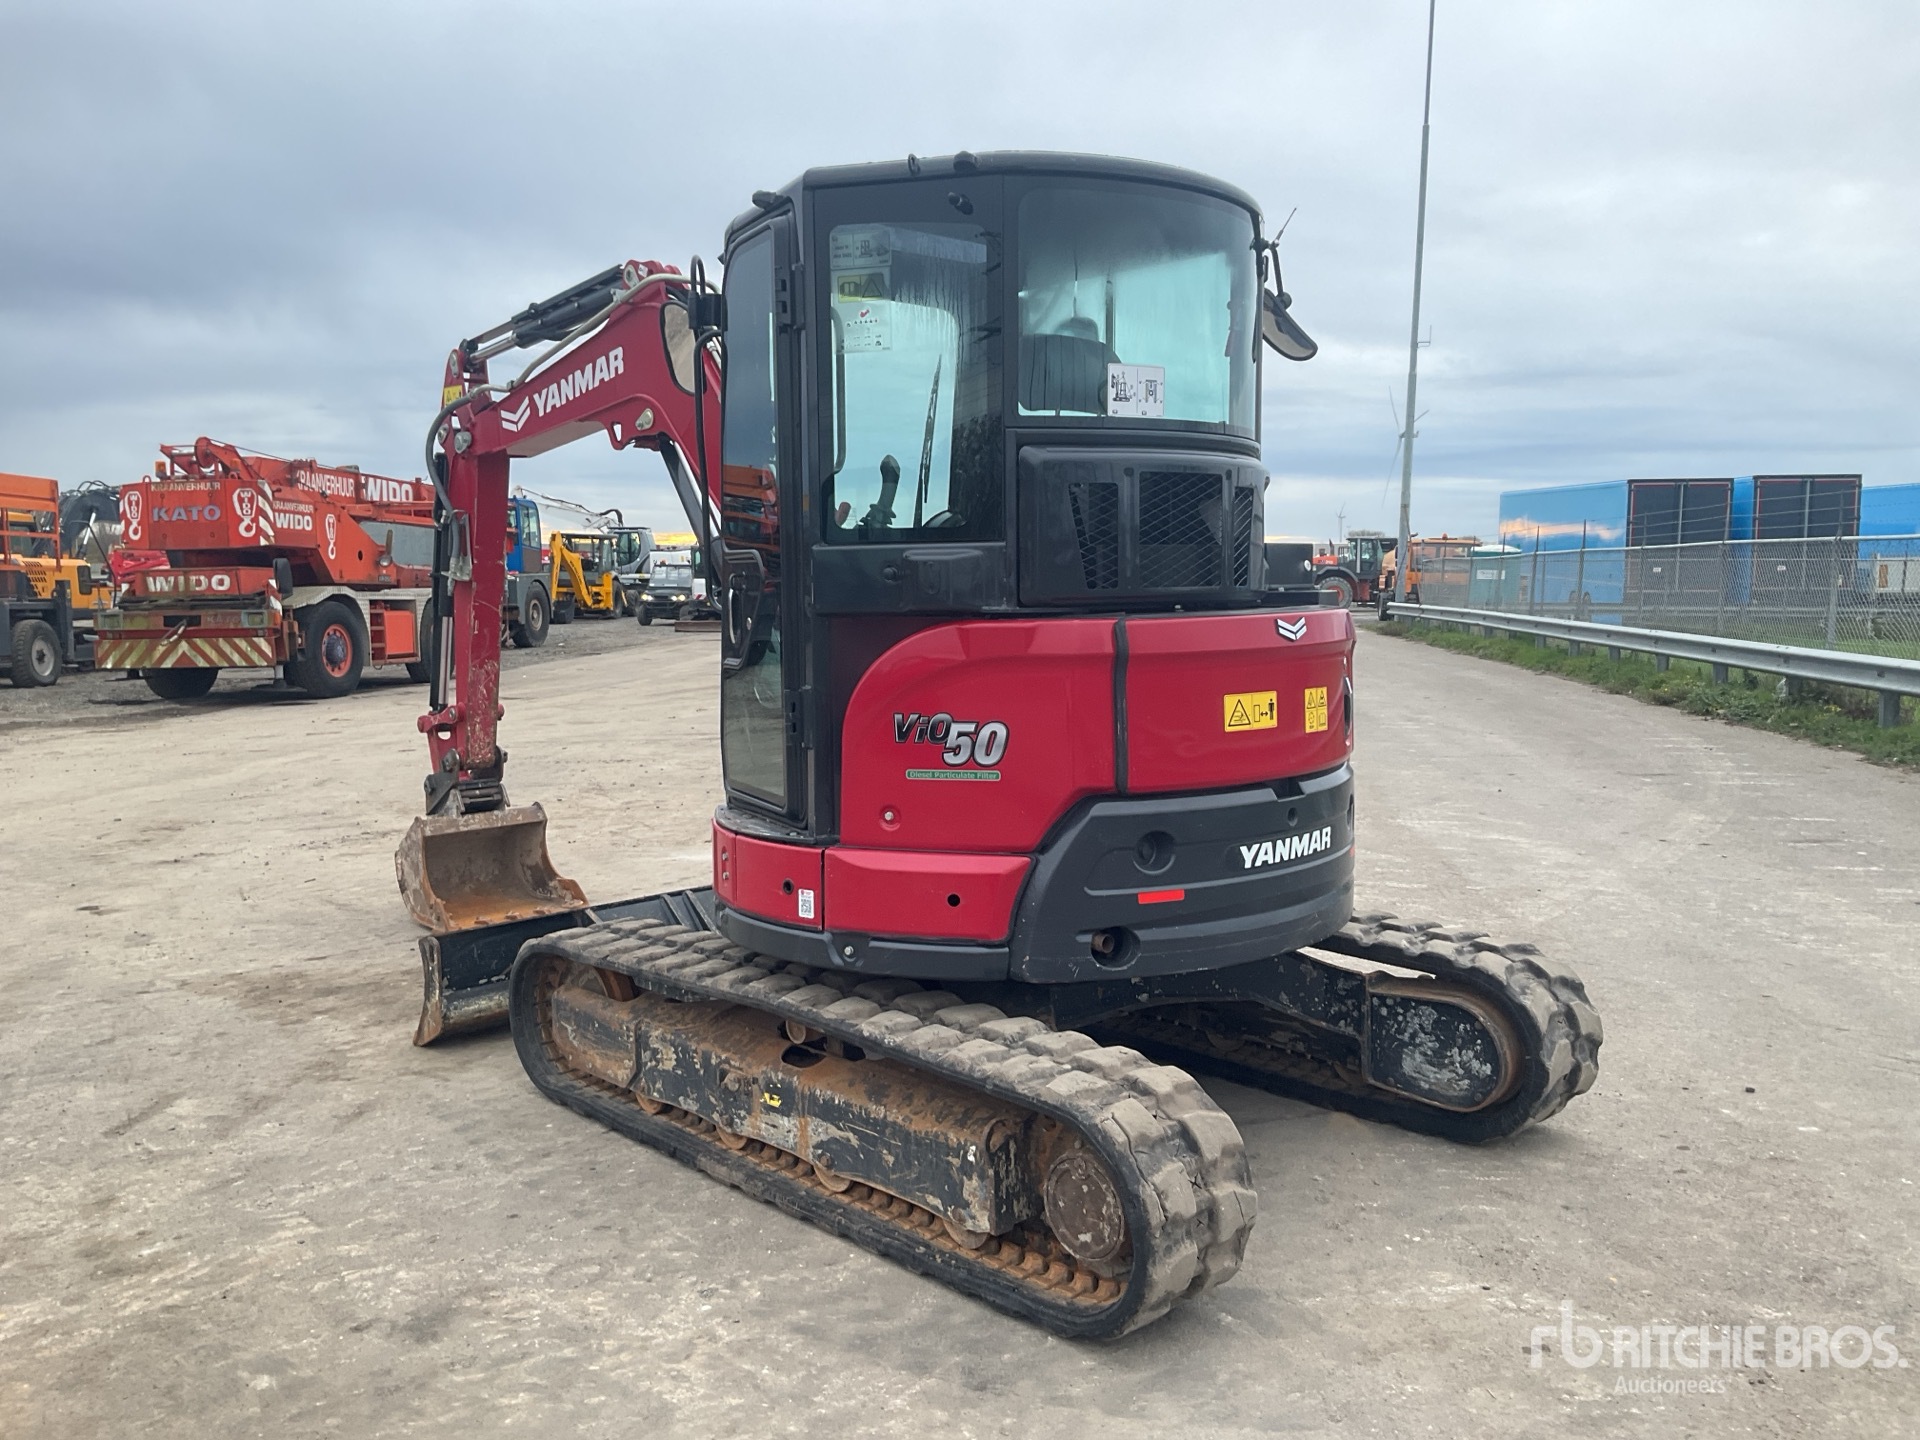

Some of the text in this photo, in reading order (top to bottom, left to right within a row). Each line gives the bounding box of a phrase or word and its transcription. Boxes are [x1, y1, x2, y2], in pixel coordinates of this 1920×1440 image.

[533, 346, 624, 417] YANMAR
[151, 481, 220, 492] KRAANVERHUUR
[362, 475, 413, 503] WIDO
[240, 491, 251, 515] WIDO
[273, 500, 314, 513] KRAANVERHUUR
[152, 505, 221, 521] KATO
[274, 512, 313, 531] WIDO
[146, 574, 231, 592] WIDO
[909, 770, 932, 778] Diesel
[934, 771, 975, 780] Particulate
[1240, 826, 1331, 869] YANMAR
